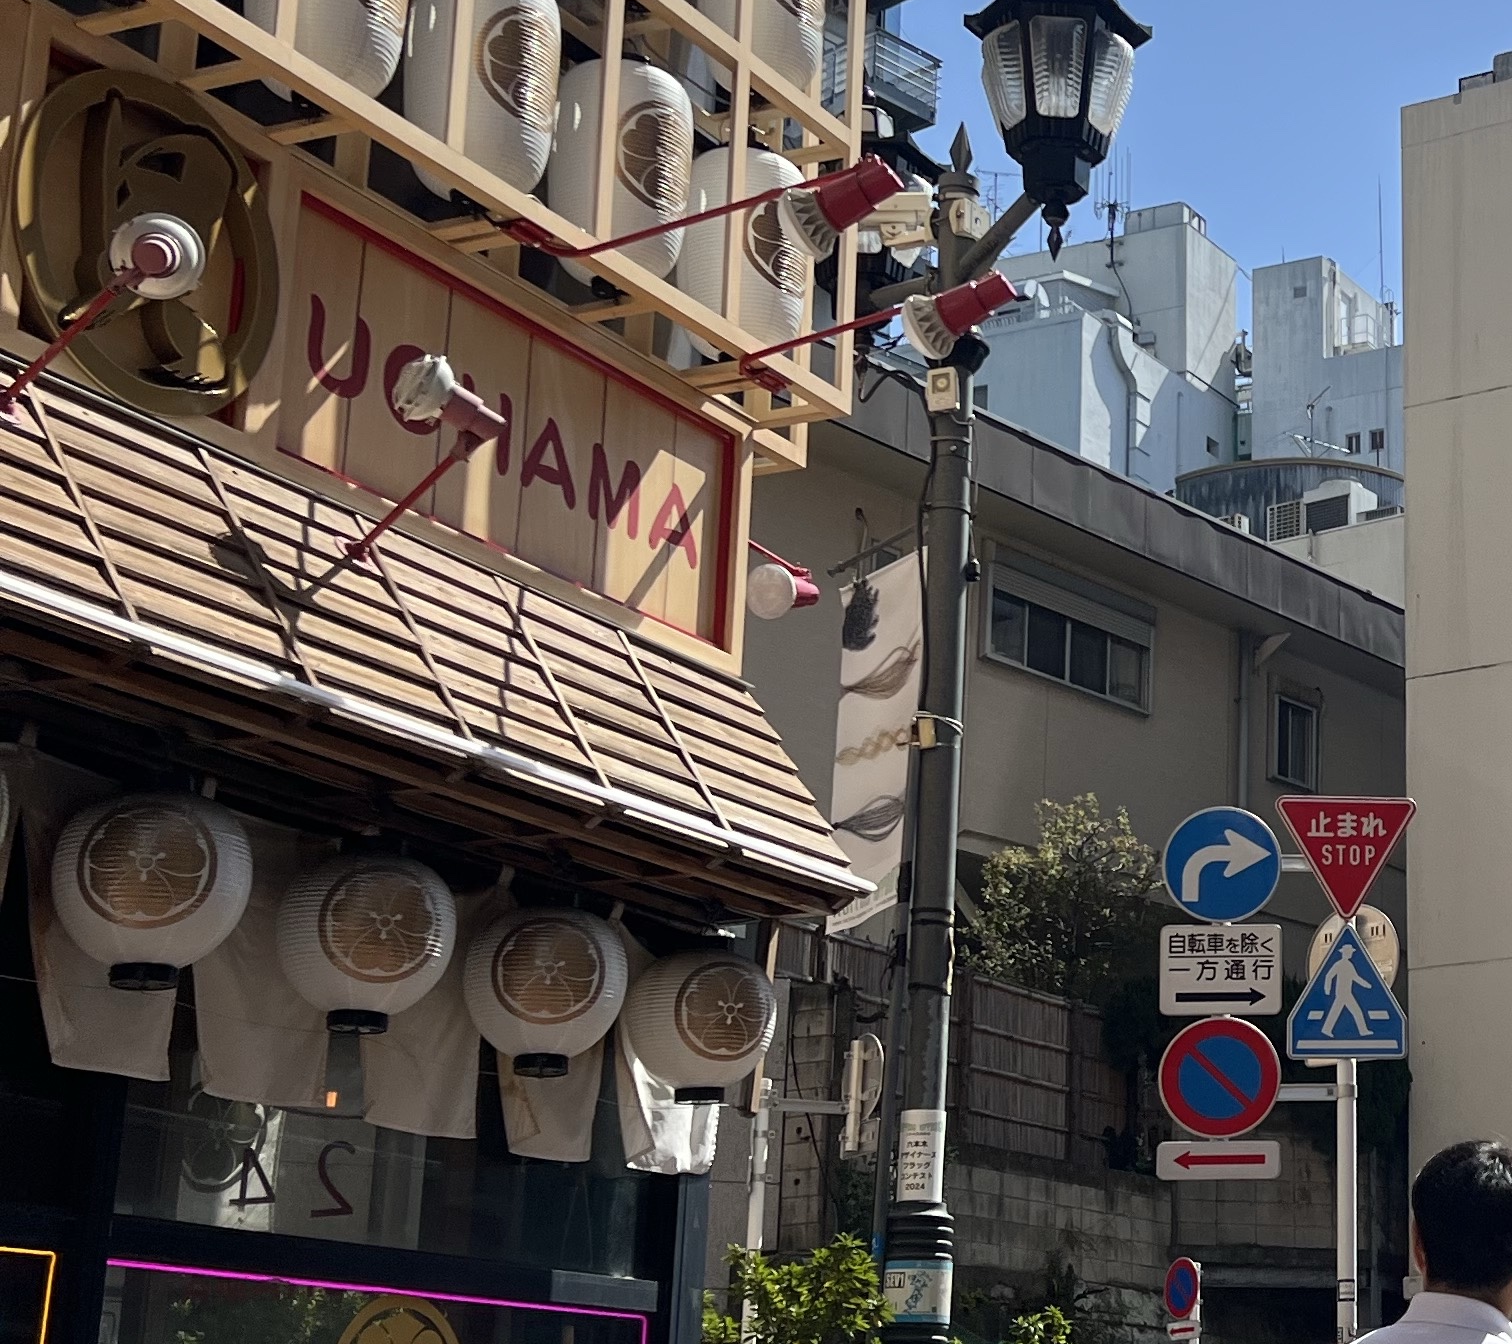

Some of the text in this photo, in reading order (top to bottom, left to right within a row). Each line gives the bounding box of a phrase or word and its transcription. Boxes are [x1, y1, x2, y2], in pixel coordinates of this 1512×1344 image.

[1307, 810, 1387, 838] 止まれ
[1321, 844, 1376, 866] STOP
[1168, 932, 1275, 954] 自転車を除く
[1168, 959, 1275, 981] 一方通行
